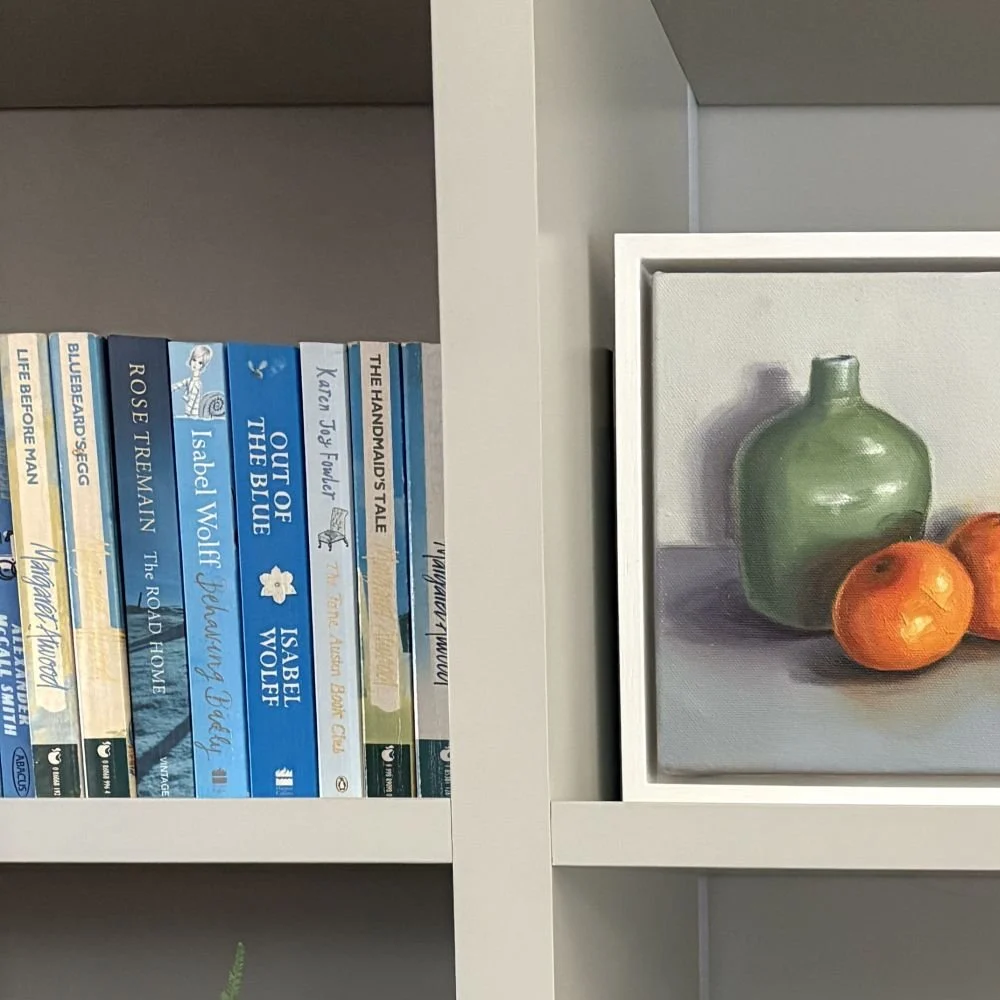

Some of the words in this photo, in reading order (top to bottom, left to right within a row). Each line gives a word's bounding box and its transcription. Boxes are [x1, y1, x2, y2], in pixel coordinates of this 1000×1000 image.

[17, 349, 31, 380] LIFE
[316, 367, 338, 411] Karen
[369, 354, 382, 386] THE
[20, 384, 35, 444] BEFORE
[67, 343, 86, 449] BLUEBEARD'S
[129, 363, 148, 423] ROSE
[247, 417, 267, 465] THE
[269, 432, 289, 484] OUT
[318, 420, 336, 448] Joy
[371, 390, 386, 490] HANDMAID'S
[24, 449, 38, 485] MAN
[76, 454, 89, 486] EGG
[133, 431, 155, 534] TREMAIN
[191, 430, 217, 495] Isabel
[320, 453, 339, 500] Fowler
[250, 472, 270, 536] BLUE
[273, 491, 291, 523] OF
[374, 493, 387, 533] TALE
[195, 501, 221, 568] Wolff
[144, 552, 158, 579] The
[146, 586, 162, 634] ROAD
[194, 572, 229, 682] Behaving
[149, 642, 166, 694] HOME
[259, 628, 280, 707] WOLFF
[280, 628, 301, 708] ISABEL
[195, 687, 232, 760] Badly
[159, 757, 169, 796] VINTAGE
